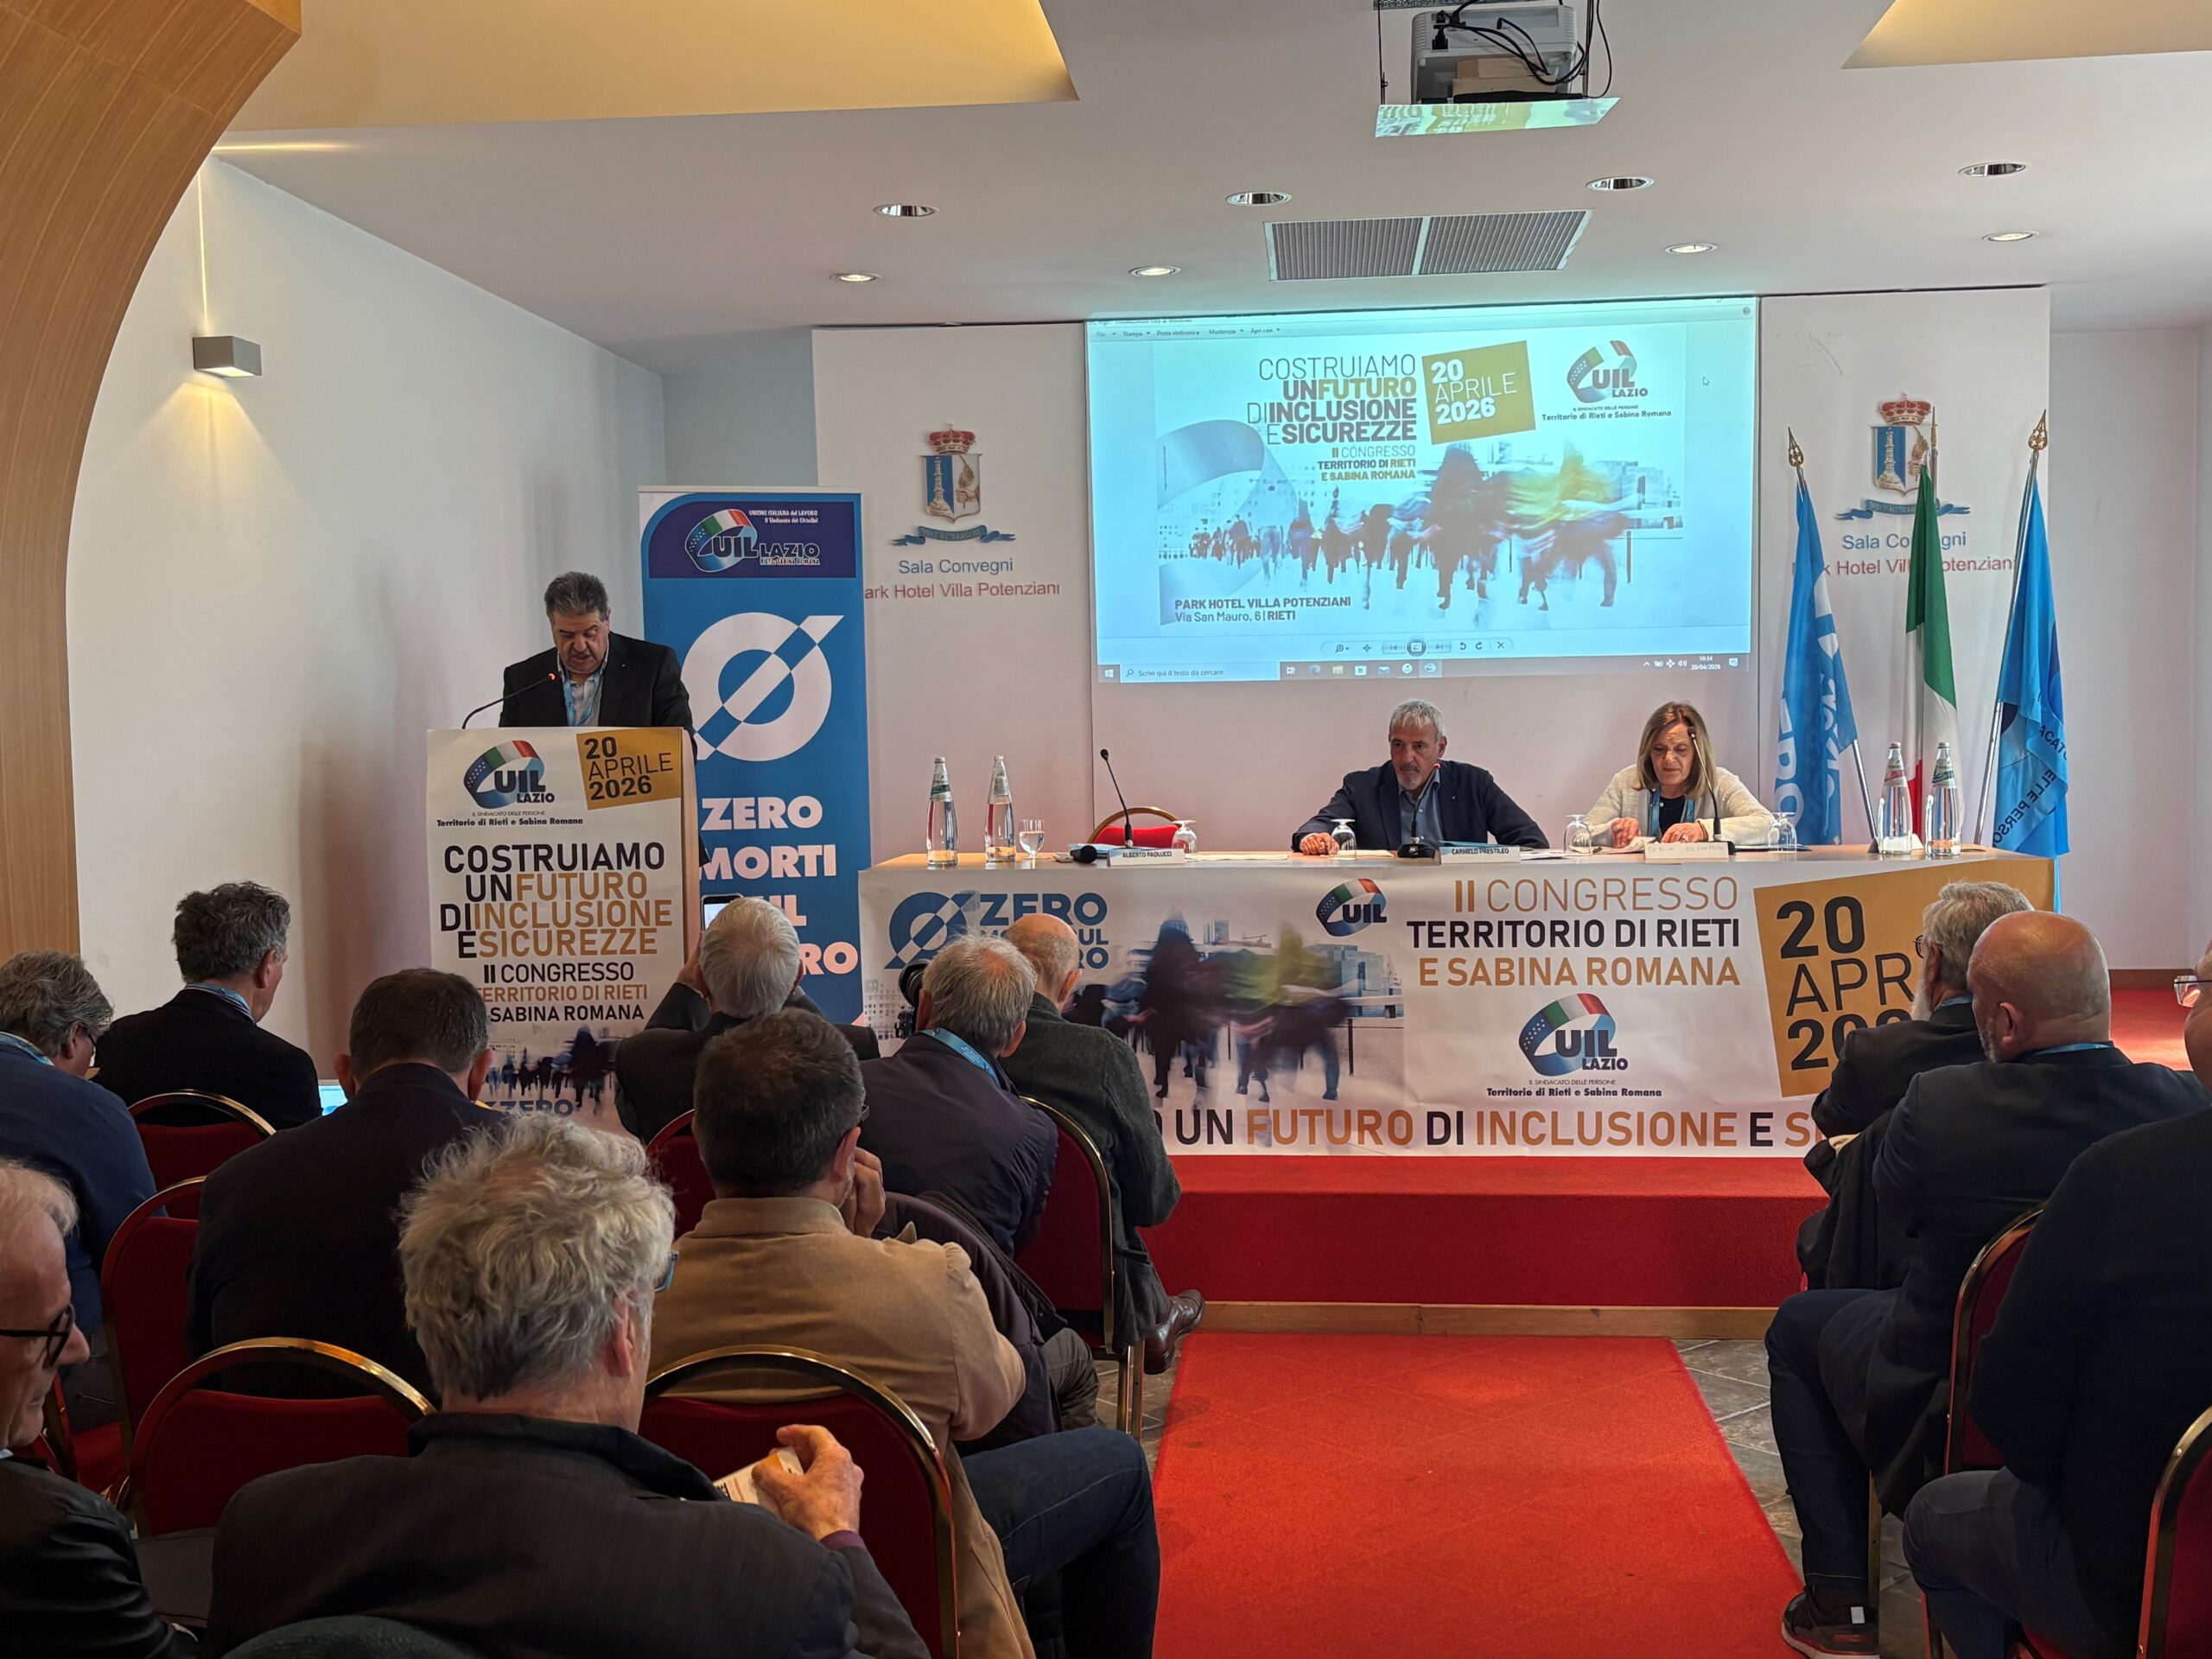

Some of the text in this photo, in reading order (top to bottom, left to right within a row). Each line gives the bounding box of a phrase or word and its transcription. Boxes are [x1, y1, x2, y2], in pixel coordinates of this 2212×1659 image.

[1259, 353, 1415, 380] COSTRUIAMO
[1431, 359, 1464, 384] 20
[1434, 372, 1518, 404] APRILE
[1592, 368, 1635, 390] UIL
[1611, 387, 1649, 398] LAZIO
[1435, 396, 1497, 425] 2026
[1542, 412, 1577, 421] Territorio
[1332, 445, 1415, 459] II CONGRESSO
[1317, 458, 1416, 470] TERRITORIO DI RIETI
[1321, 469, 1415, 481] E SABINA ROMANA
[712, 536, 759, 558] UIL
[760, 543, 820, 558] LAZIO
[1842, 534, 1880, 550] Sala
[899, 558, 1014, 575] Sala Convegni
[1837, 559, 1880, 575] Hotel
[1942, 556, 2013, 572] otenzian
[865, 582, 1061, 600] ark Hotel Villa Potenziani
[1175, 596, 1351, 610] PARK HOTEL VILLA POTENZIANI
[1175, 610, 1296, 623] Via San Mauro, 6 RIETI
[584, 736, 617, 760] 20
[588, 753, 674, 782] APRILE
[493, 770, 546, 794] UIL
[588, 775, 653, 801] 2026
[517, 792, 556, 804] LAZIO
[436, 818, 475, 827] Territorio
[478, 818, 486, 827] di
[518, 817, 547, 826] Sabina
[701, 795, 823, 830] ZERO
[444, 842, 664, 874] COSTRUIAMO
[699, 844, 837, 880] MORTI
[1455, 876, 1738, 912] II CONGRESSO
[980, 892, 1109, 926] ZERO
[1342, 904, 1387, 924] UIL
[1407, 918, 1739, 949] TERRITORIO DI RIETI
[1777, 895, 1866, 959] 20
[483, 962, 634, 983] II CONGRESSO
[1419, 957, 1741, 987] E SABINA ROMANA
[476, 983, 648, 1003] ERRITORIO DI RIETI
[1785, 952, 1915, 1017] APR
[490, 1004, 645, 1022] SABINA ROMANA
[1555, 1029, 1618, 1058] UIL
[1582, 1057, 1629, 1071] LAZIO
[1487, 1087, 1532, 1096] Territorio
[1535, 1087, 1545, 1096] di
[1548, 1087, 1571, 1096] Rieti
[1584, 1087, 1618, 1096] Sabina
[1621, 1087, 1662, 1096] Romana
[1175, 1109, 1233, 1146] UN
[1247, 1109, 1414, 1146] FUTURO
[1426, 1110, 1464, 1146] DI
[1477, 1110, 1738, 1147] INCLUSIONE
[1750, 1112, 1774, 1147] E
